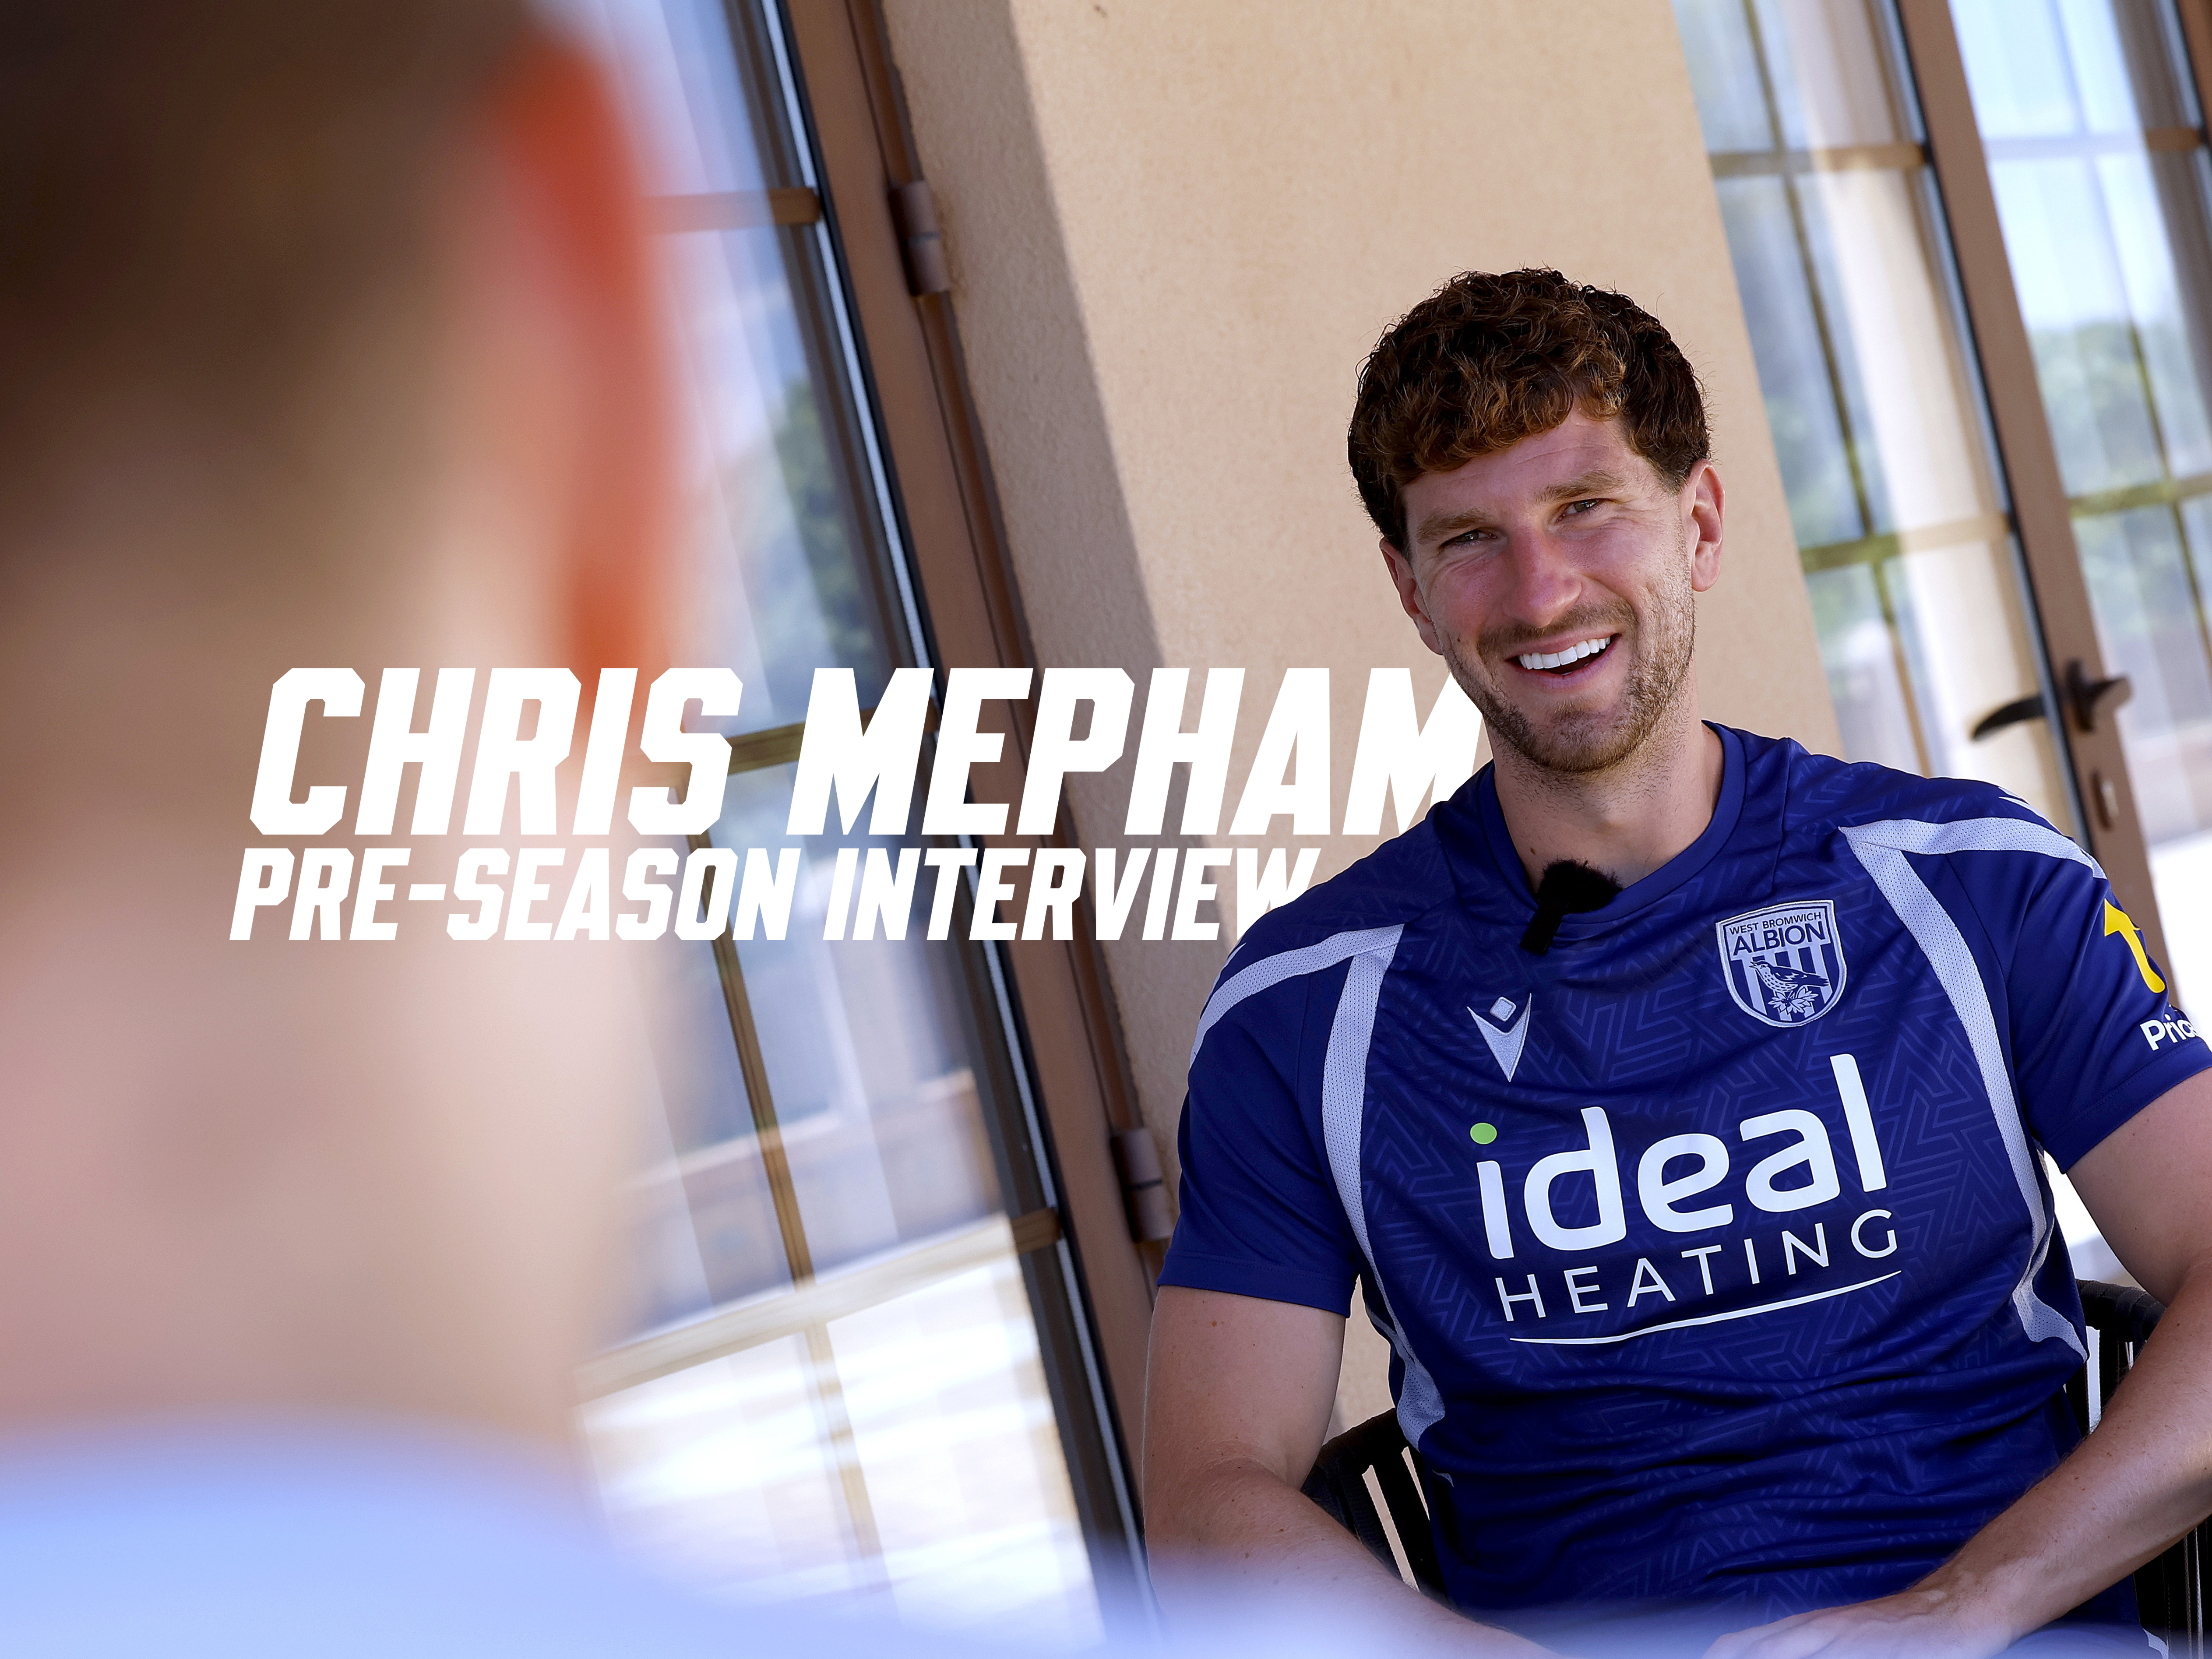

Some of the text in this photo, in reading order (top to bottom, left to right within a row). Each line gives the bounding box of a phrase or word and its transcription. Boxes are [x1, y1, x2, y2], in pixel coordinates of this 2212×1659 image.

[1729, 911, 1821, 935] WEST BROMWICH
[1733, 920, 1826, 956] ALBION
[1470, 1053, 1887, 1259] ideal
[1495, 1209, 1898, 1321] HEATING
